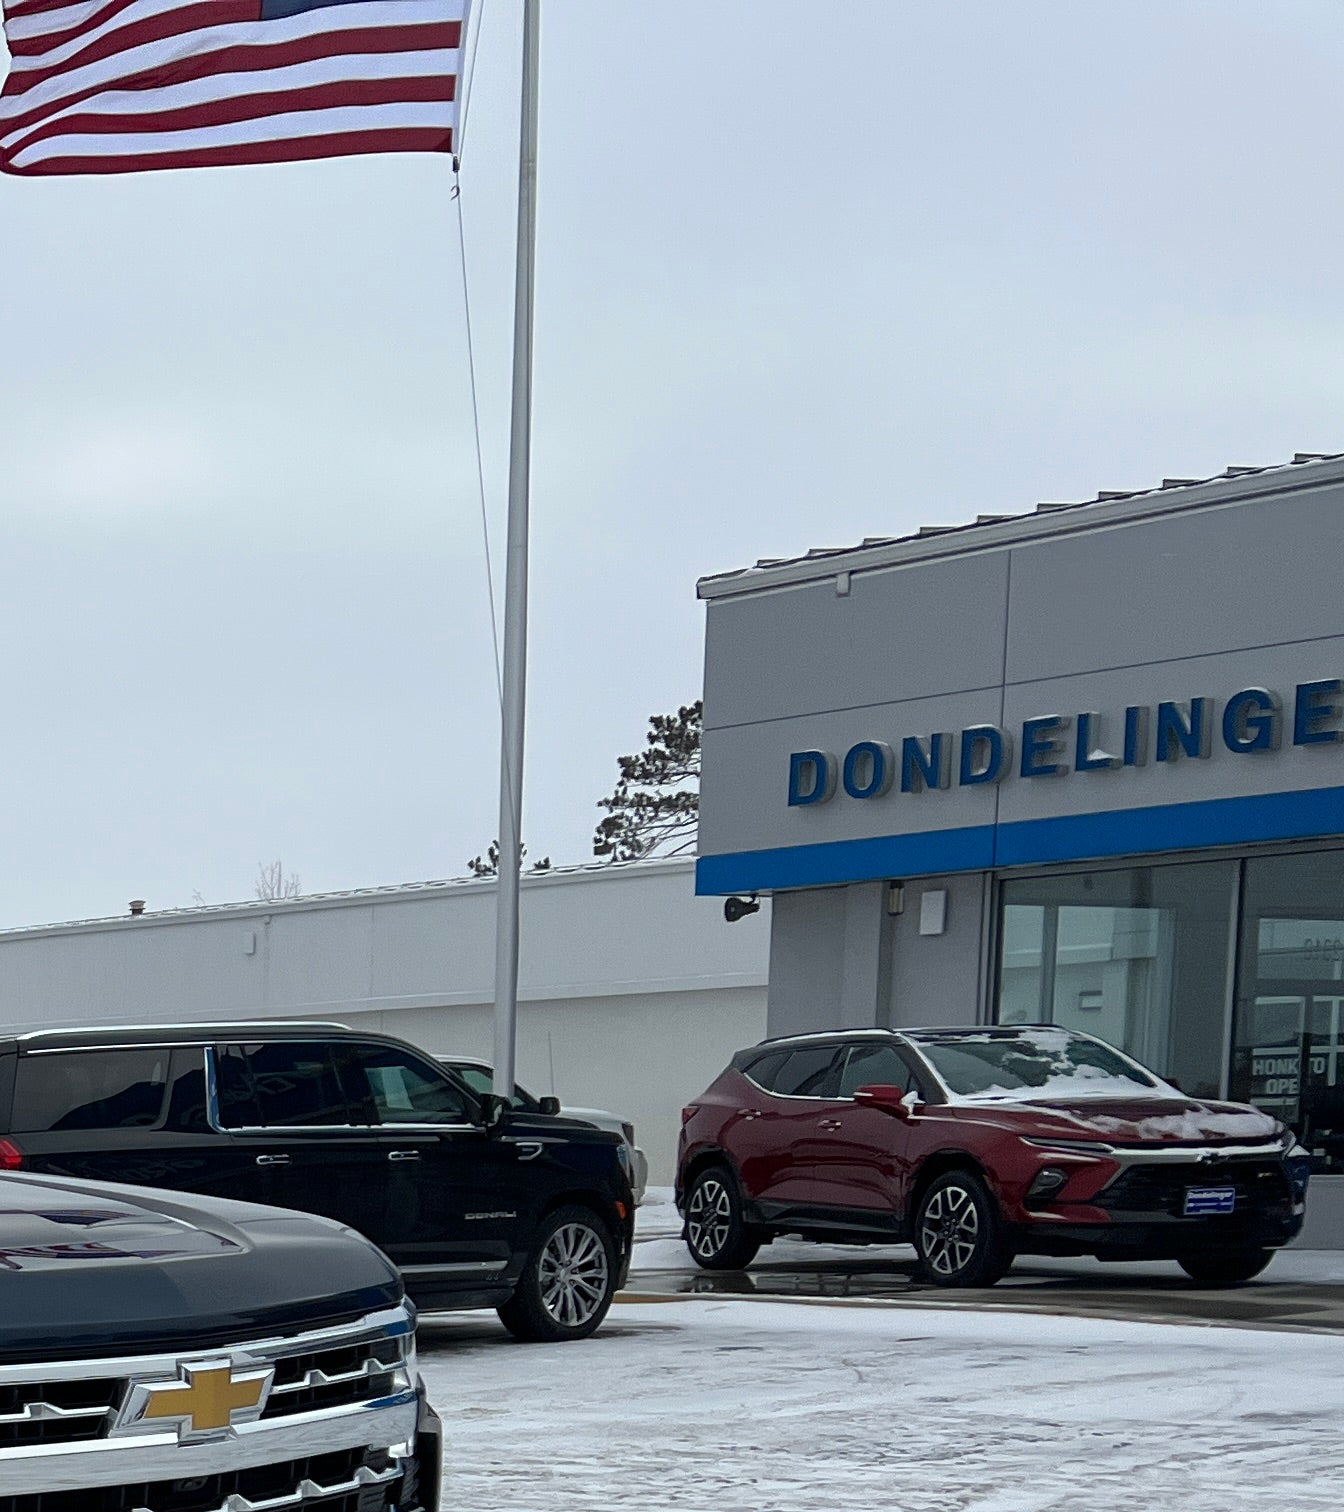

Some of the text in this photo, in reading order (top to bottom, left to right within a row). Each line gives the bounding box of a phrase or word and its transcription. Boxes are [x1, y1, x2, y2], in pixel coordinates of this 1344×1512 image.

[1252, 1057, 1300, 1076] HONK
[1265, 1077, 1299, 1095] OPE
[464, 1210, 517, 1220] DENALI
